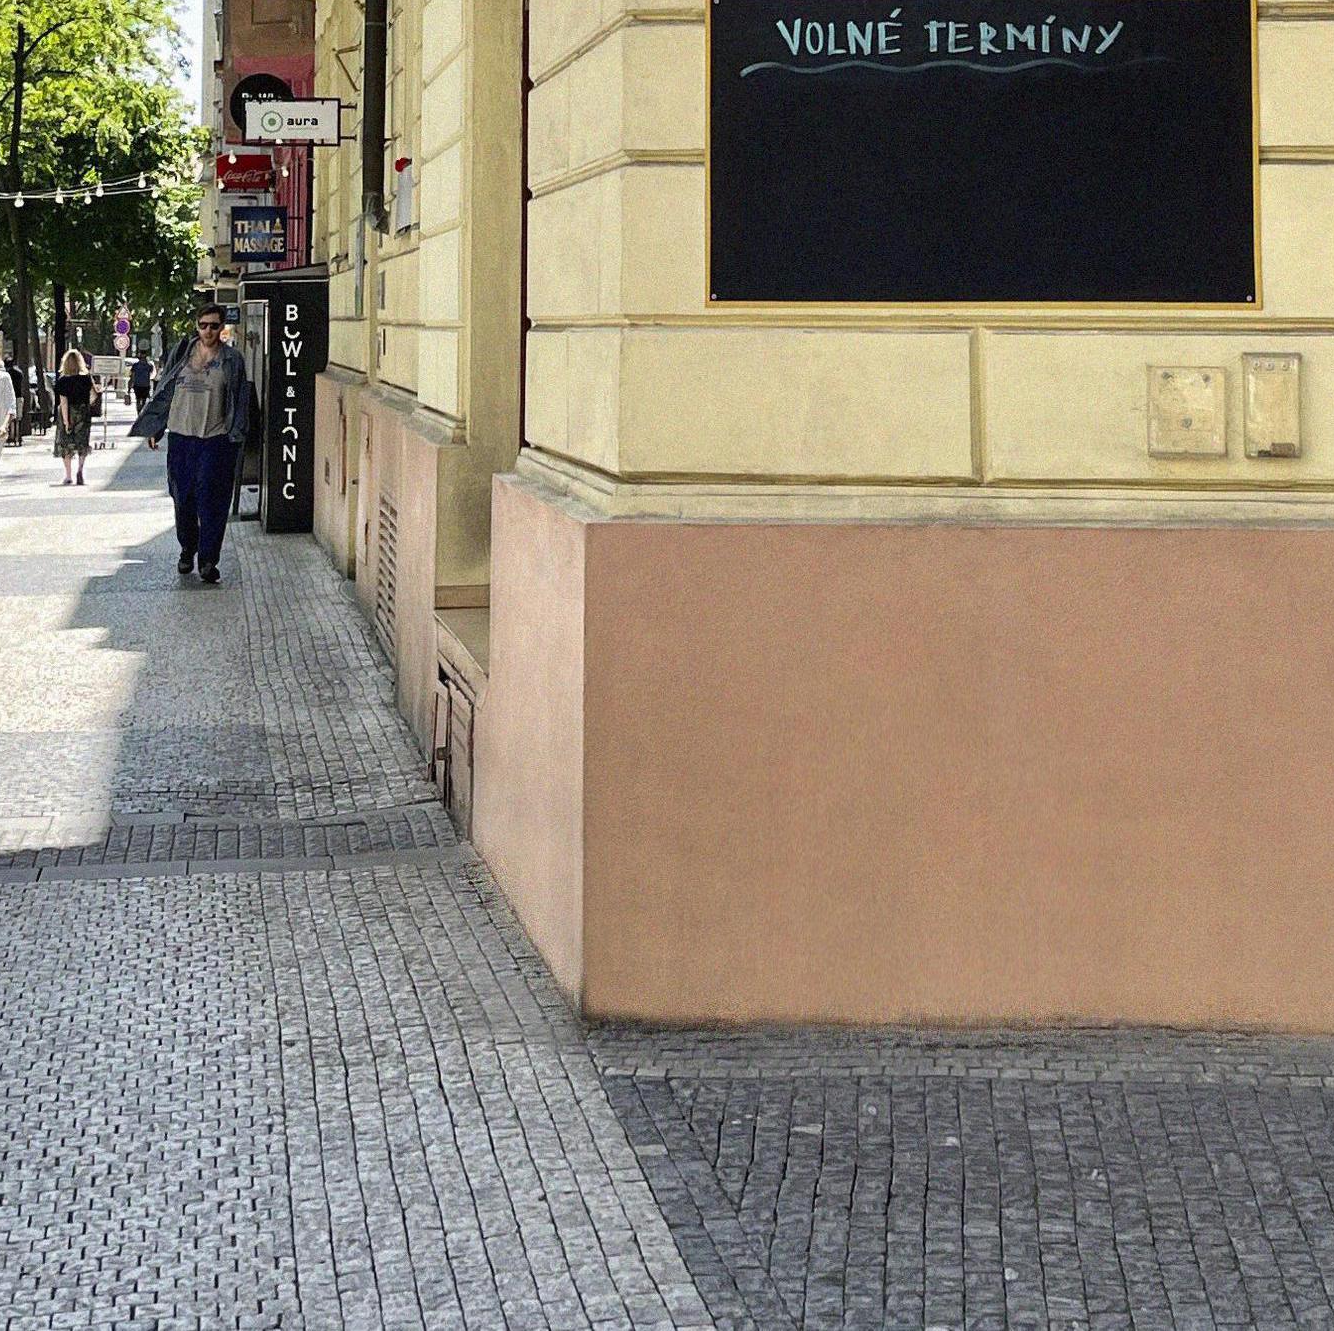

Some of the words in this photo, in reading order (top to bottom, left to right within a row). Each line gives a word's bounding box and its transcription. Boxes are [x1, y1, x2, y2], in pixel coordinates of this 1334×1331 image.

[775, 7, 903, 56] VOLNÉ
[923, 14, 1124, 56] TERMÍNY
[286, 117, 319, 126] aura
[233, 219, 271, 234] THAI
[233, 236, 285, 253] MASSAGE
[281, 303, 303, 376] BOWL
[285, 385, 296, 398] &
